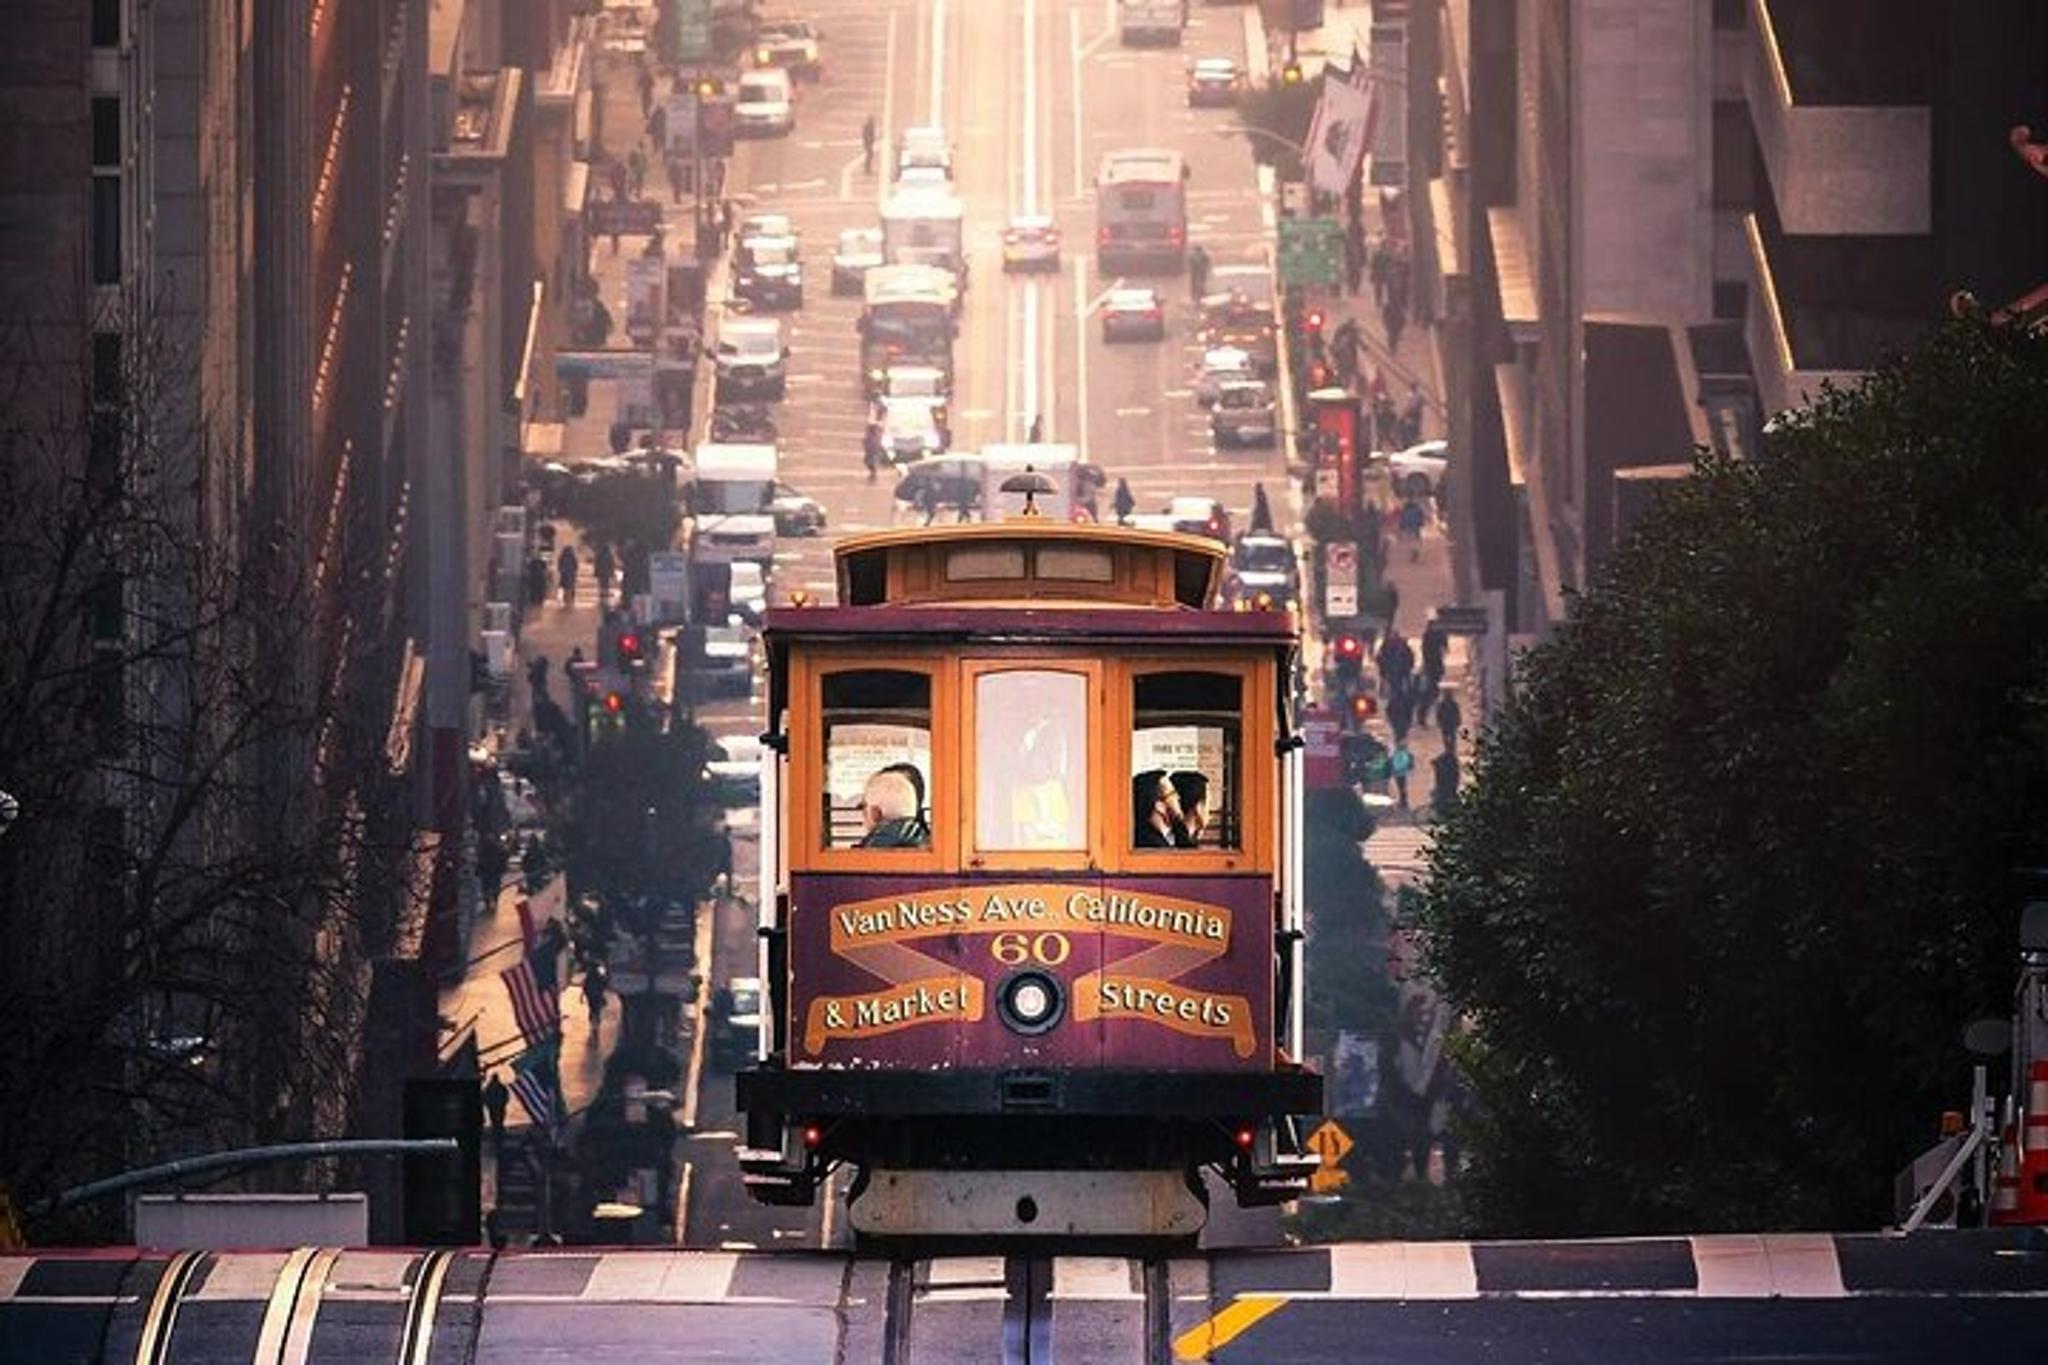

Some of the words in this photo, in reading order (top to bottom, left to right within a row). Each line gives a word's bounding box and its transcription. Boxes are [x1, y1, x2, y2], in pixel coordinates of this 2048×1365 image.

[840, 909, 891, 937] Van
[896, 898, 973, 930] Ness
[1066, 891, 1223, 939] California
[991, 932, 1071, 965] 60
[825, 1000, 850, 1029] &
[855, 984, 966, 1028] Market
[1100, 982, 1232, 1026] Streets
